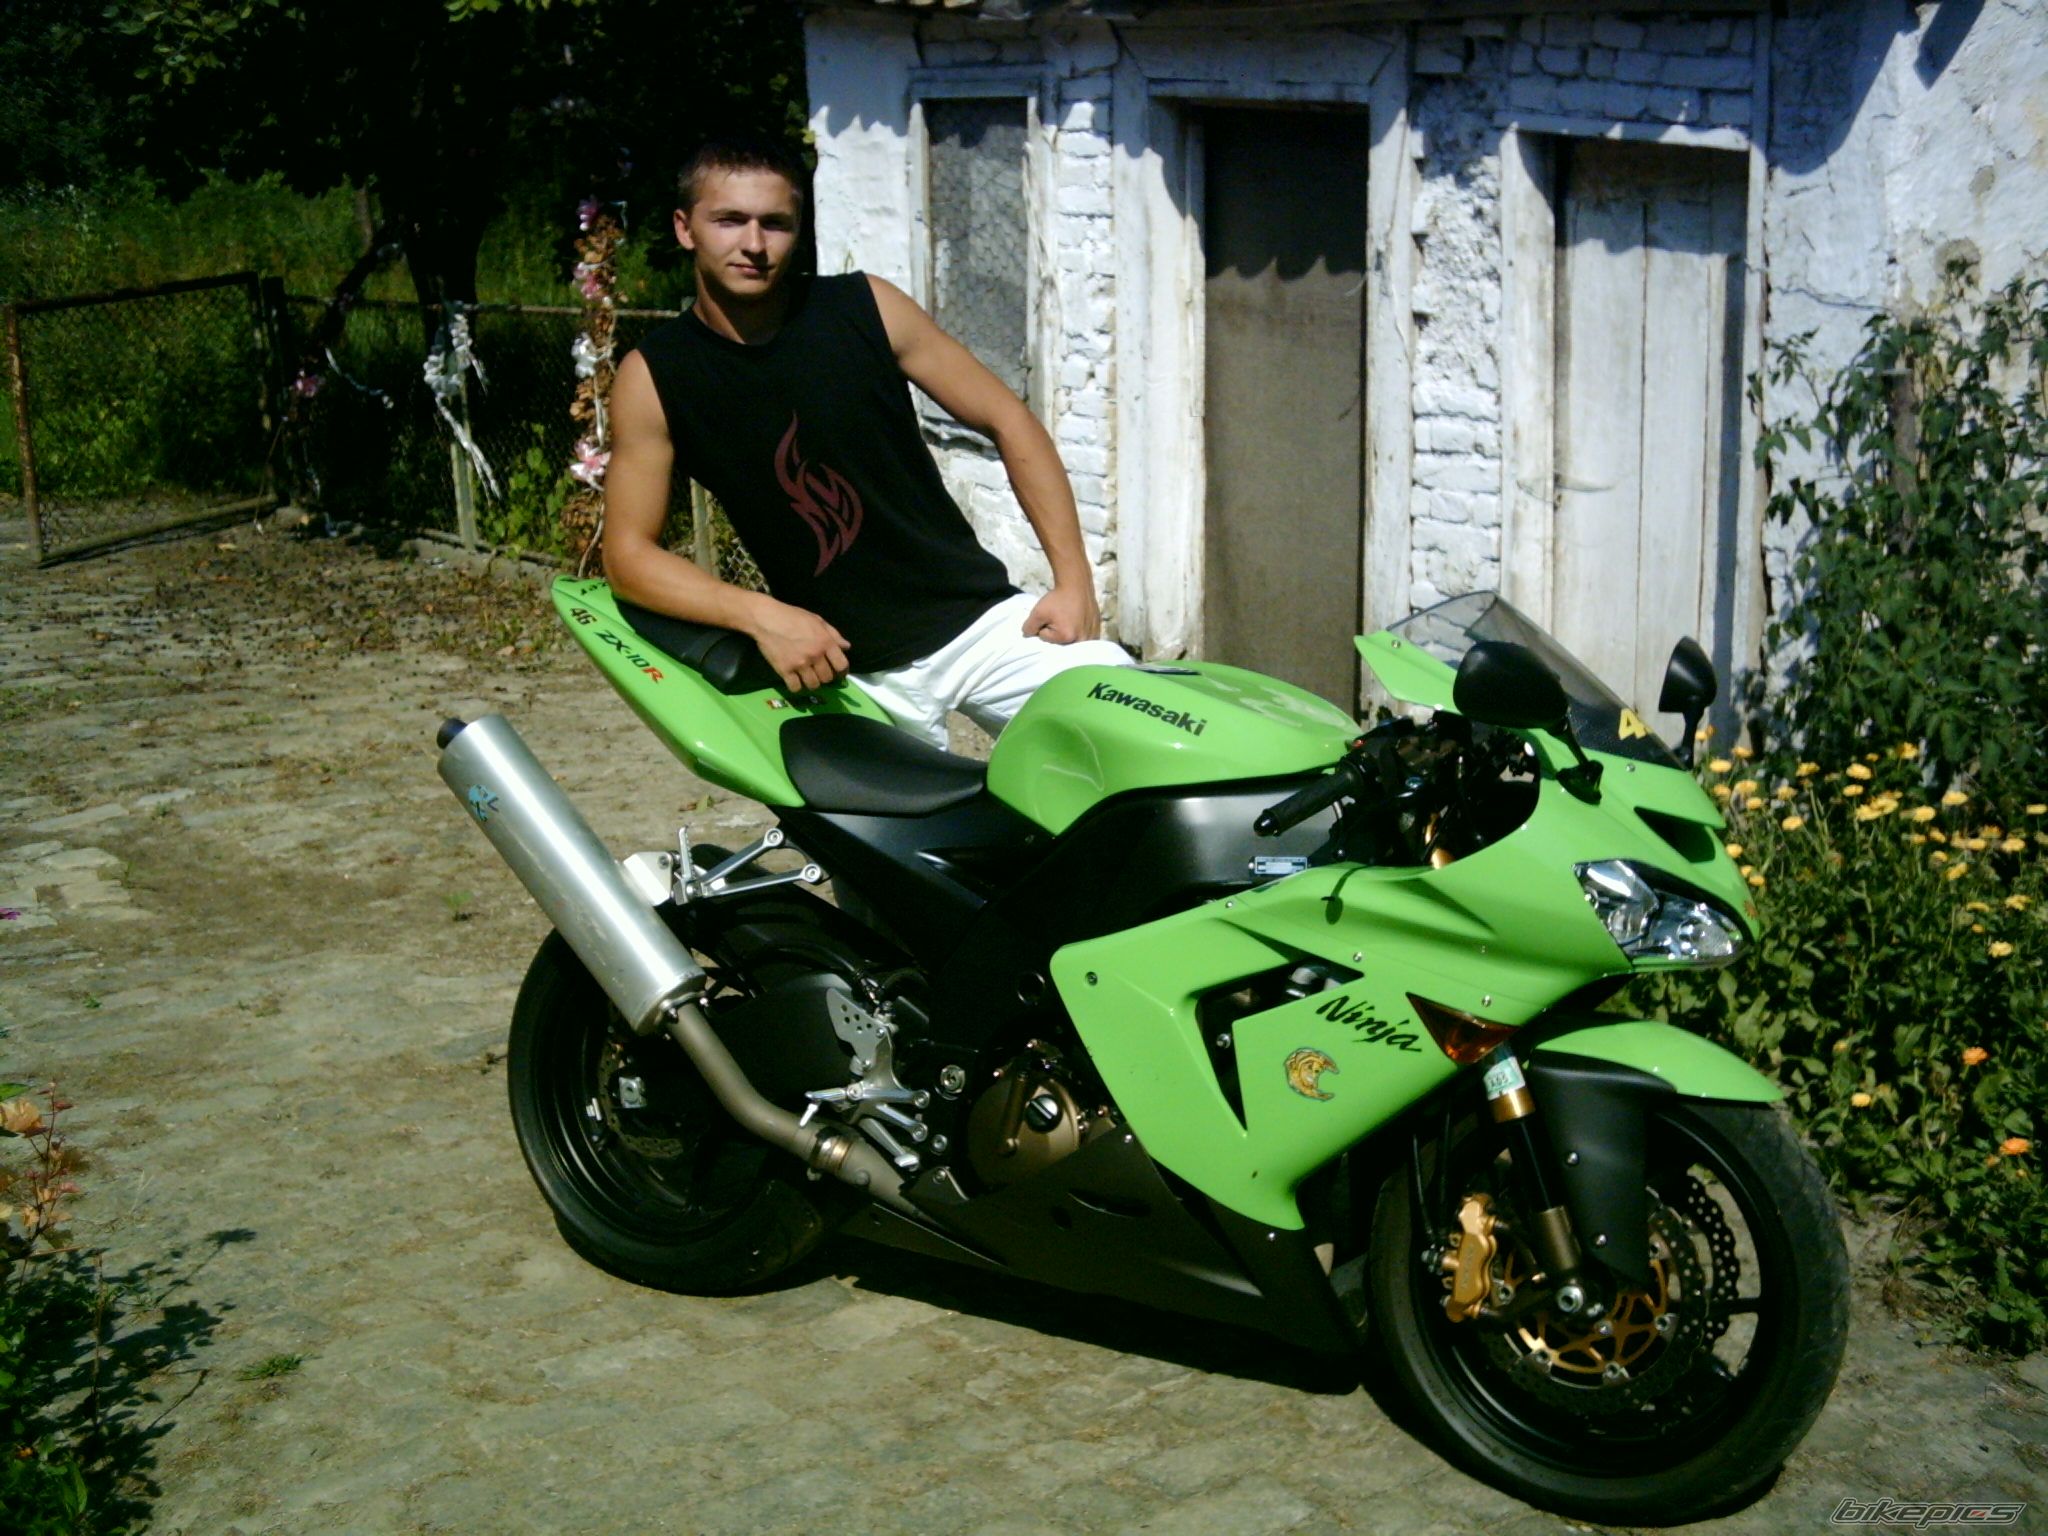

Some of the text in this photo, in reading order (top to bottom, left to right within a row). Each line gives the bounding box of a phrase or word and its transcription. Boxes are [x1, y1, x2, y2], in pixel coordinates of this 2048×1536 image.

[594, 629, 664, 684] ZX-10R
[1087, 682, 1208, 736] Kawasaki
[1316, 996, 1422, 1052] Ninja
